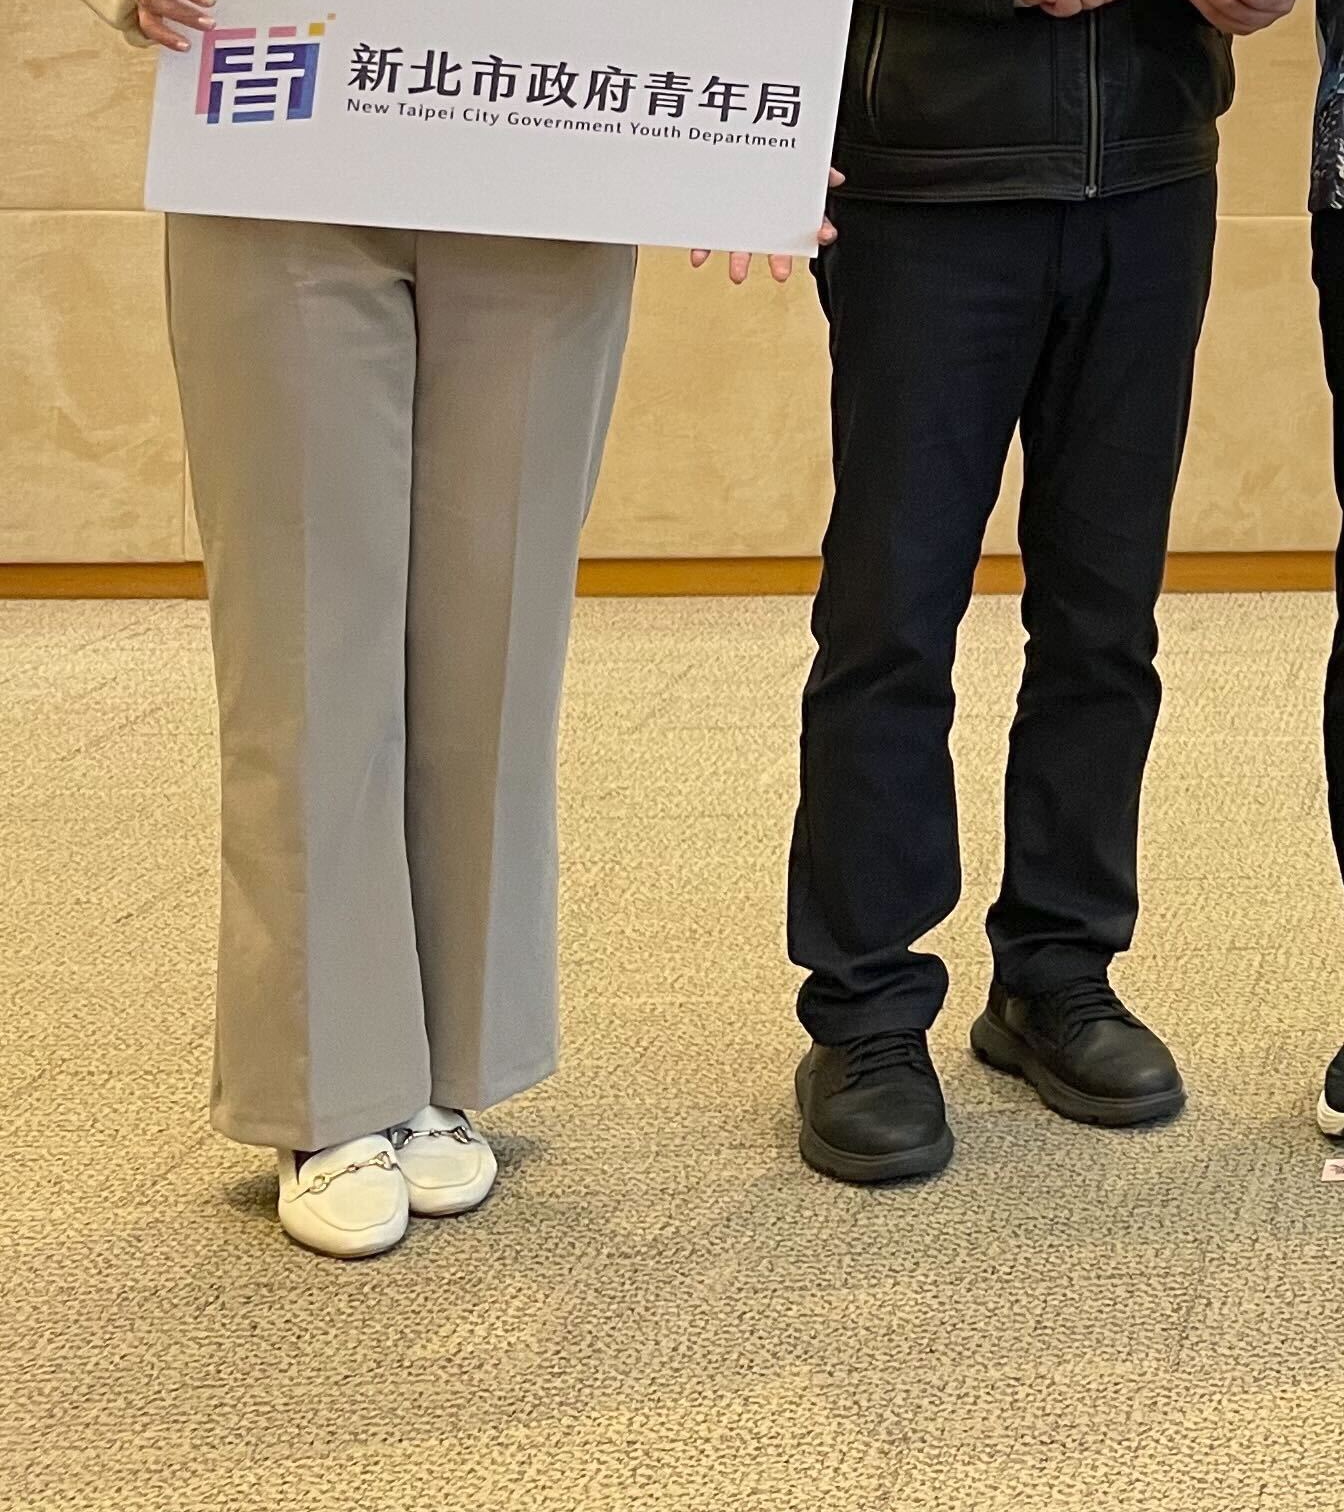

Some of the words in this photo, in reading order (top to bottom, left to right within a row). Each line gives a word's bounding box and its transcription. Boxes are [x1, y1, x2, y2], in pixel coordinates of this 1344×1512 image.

[347, 43, 801, 128] 新北市政府青年局
[347, 98, 390, 115] New
[398, 99, 456, 123] Taipei
[463, 105, 500, 127] City
[508, 110, 623, 135] Government
[630, 120, 682, 140] Youth
[689, 127, 798, 150] Department
